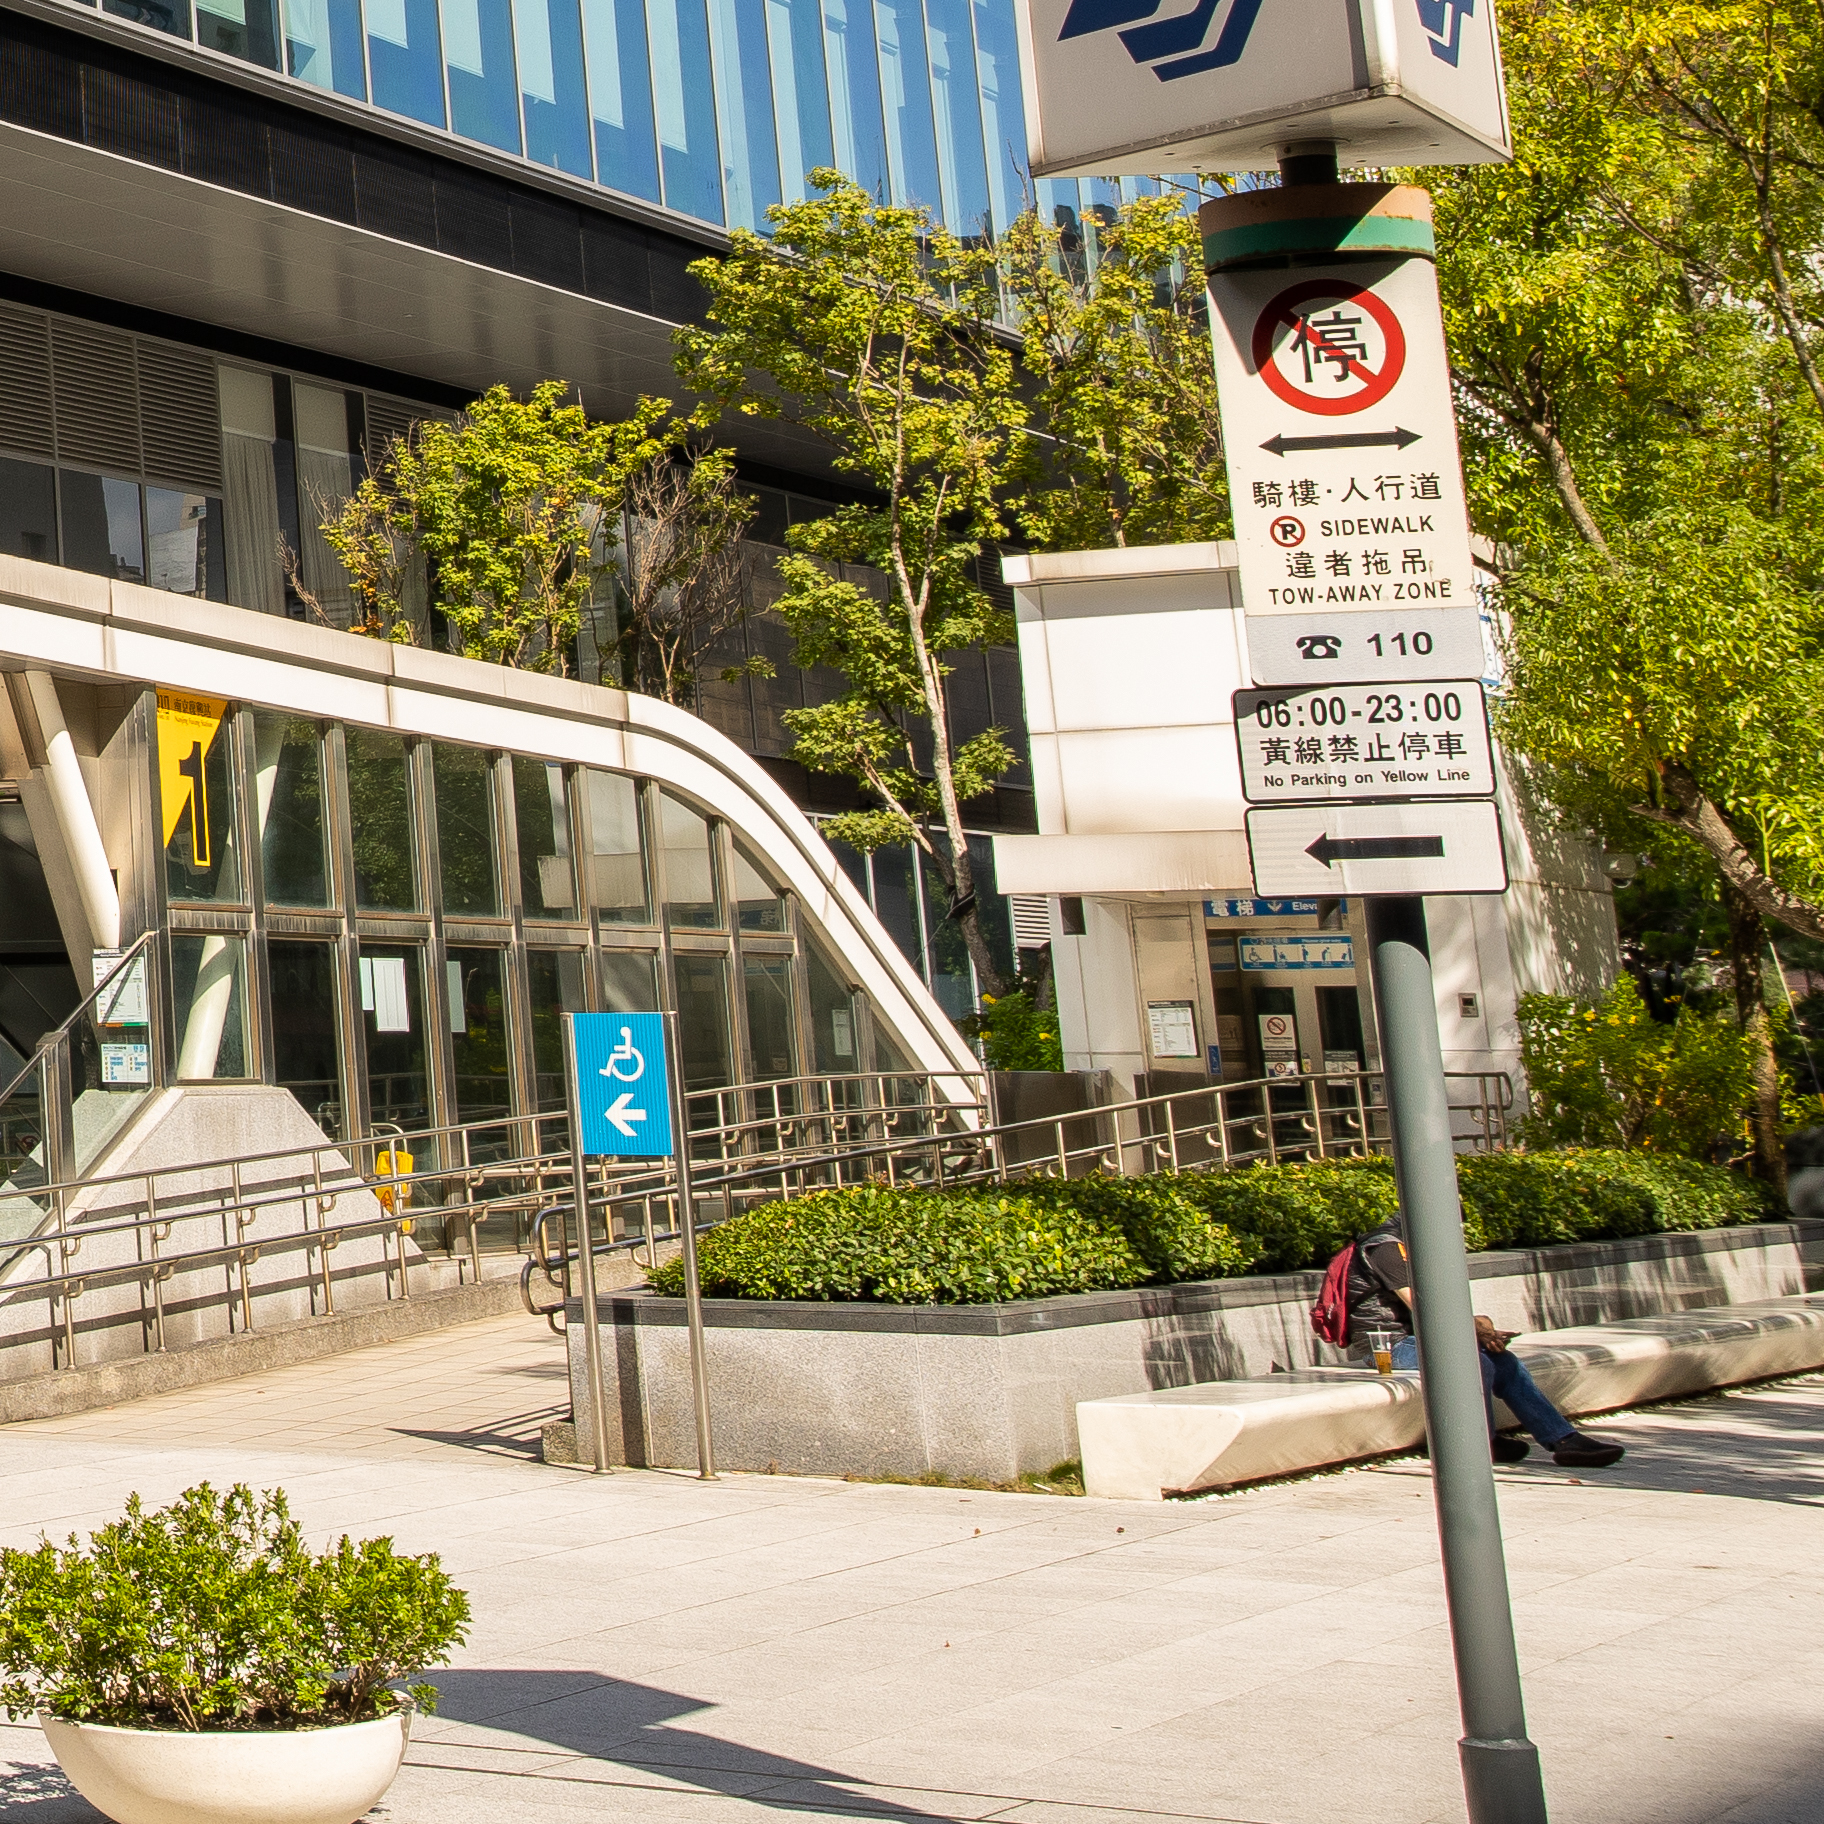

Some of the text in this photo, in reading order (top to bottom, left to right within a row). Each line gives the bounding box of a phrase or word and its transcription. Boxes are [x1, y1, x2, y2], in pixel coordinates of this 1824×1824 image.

[1289, 310, 1369, 383] 停
[1320, 515, 1435, 537] SIDEWALK
[1285, 548, 1427, 579] 違者拖吊
[1268, 581, 1453, 605] TOW-AWAY ZONE
[1366, 631, 1434, 657] 110
[1255, 692, 1462, 729] 06:00-23:00
[1259, 730, 1468, 767] 黃線禁止停車
[1263, 769, 1471, 788] No Parking on Yellow Line
[178, 740, 212, 867] 1
[1210, 899, 1254, 917] 電梯
